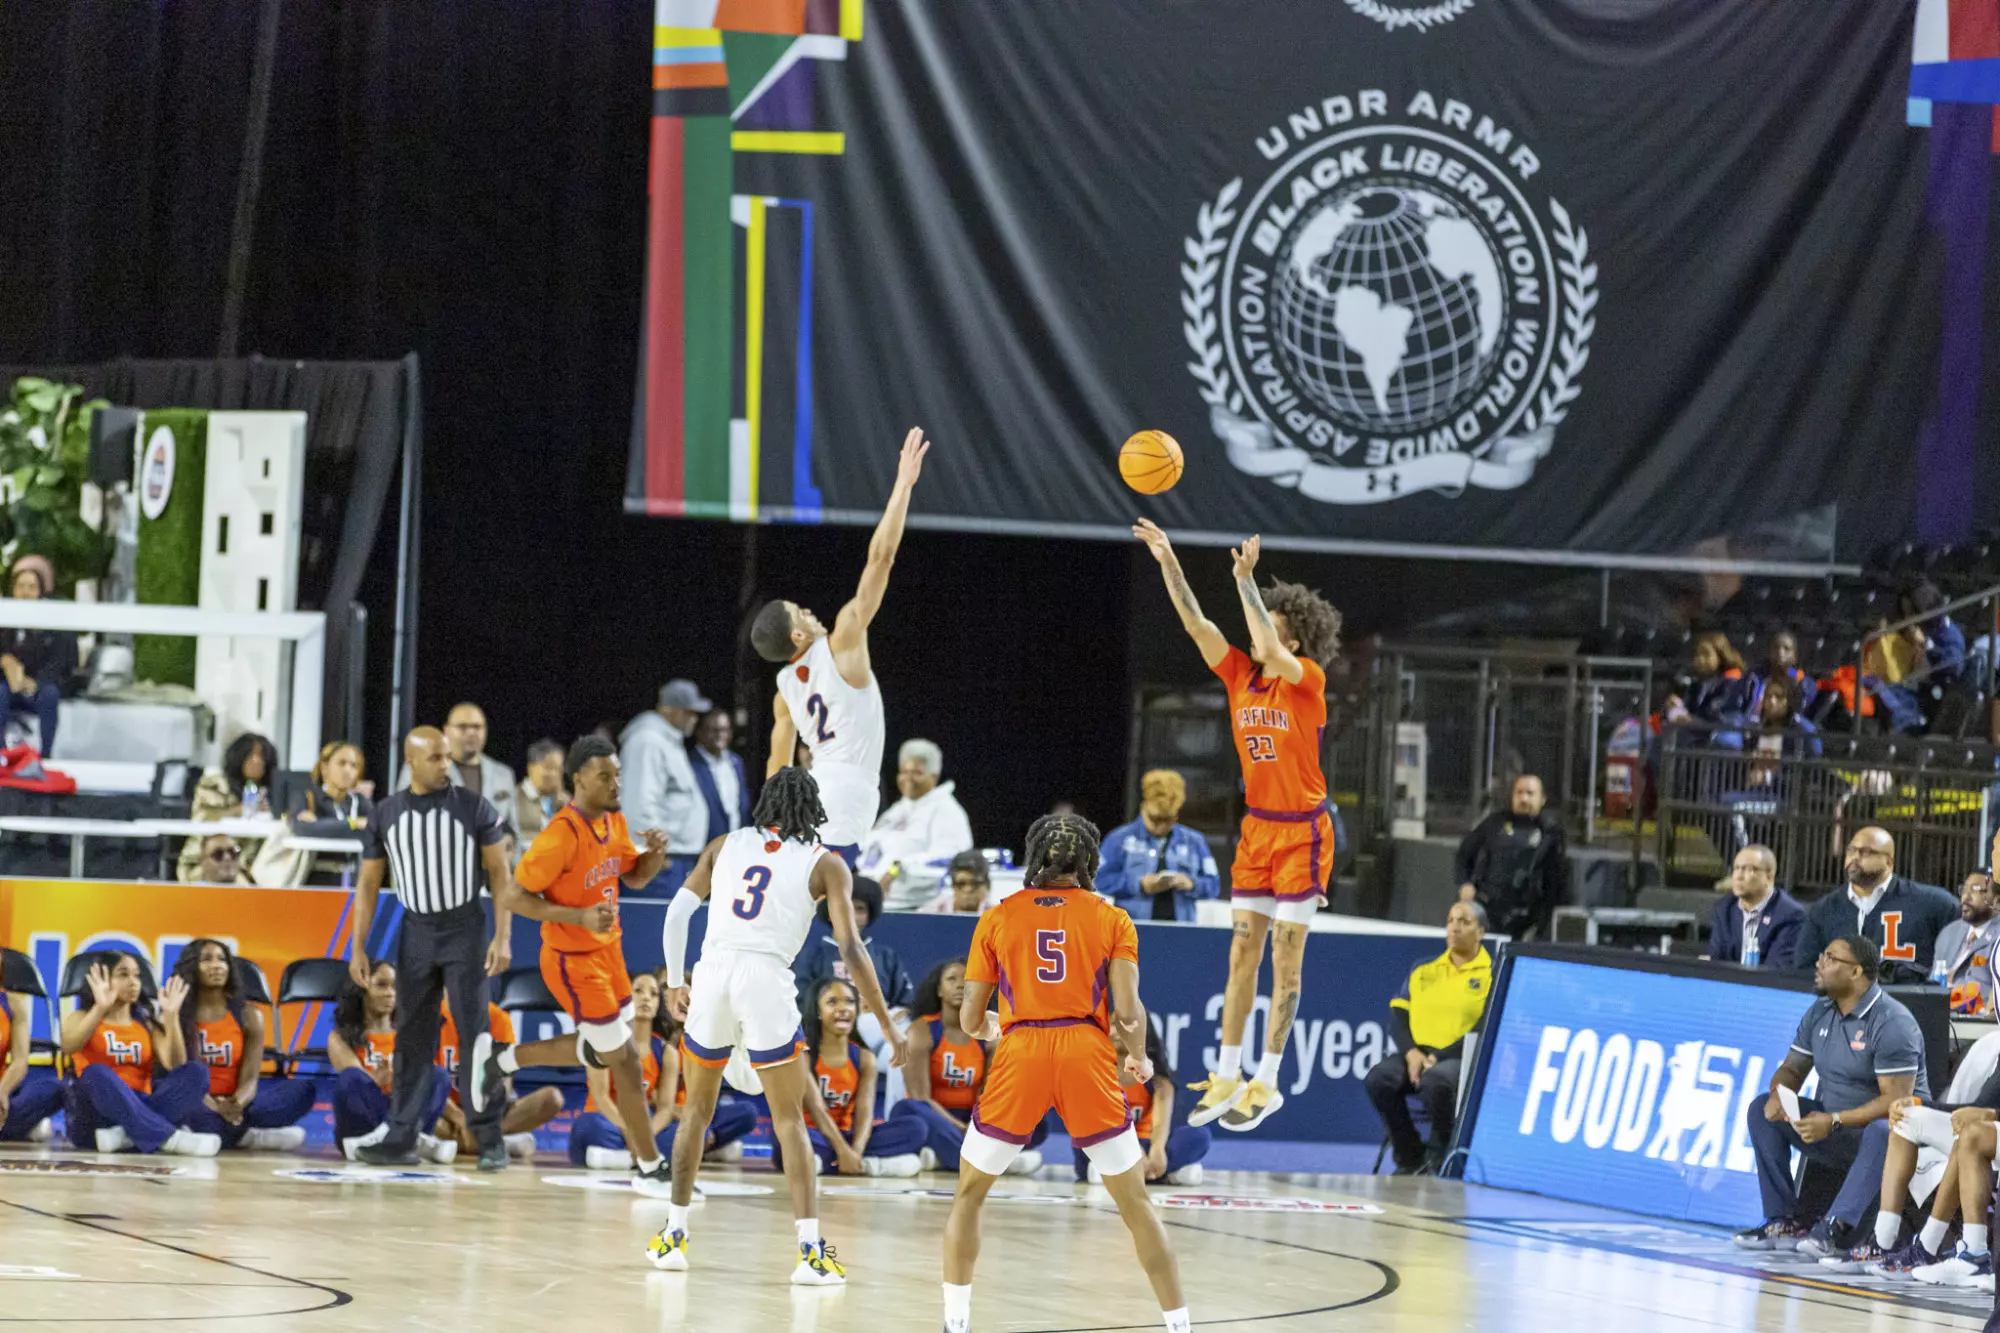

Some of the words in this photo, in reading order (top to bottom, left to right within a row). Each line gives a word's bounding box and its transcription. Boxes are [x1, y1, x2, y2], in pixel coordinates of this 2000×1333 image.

[1256, 88, 1388, 161] UNDR
[1406, 90, 1541, 180] ARMR
[1251, 144, 1369, 256] BLACK
[1379, 142, 1540, 304] LIBERATION
[1238, 264, 1359, 456] ASPIRATION
[1364, 318, 1540, 466] WORLDWIDE
[807, 693, 836, 744] 2
[1236, 706, 1289, 732] AFLIN
[732, 865, 772, 921] 3
[1880, 910, 1916, 962] L
[1036, 929, 1067, 983] 5
[1518, 1025, 1665, 1152] FOOD
